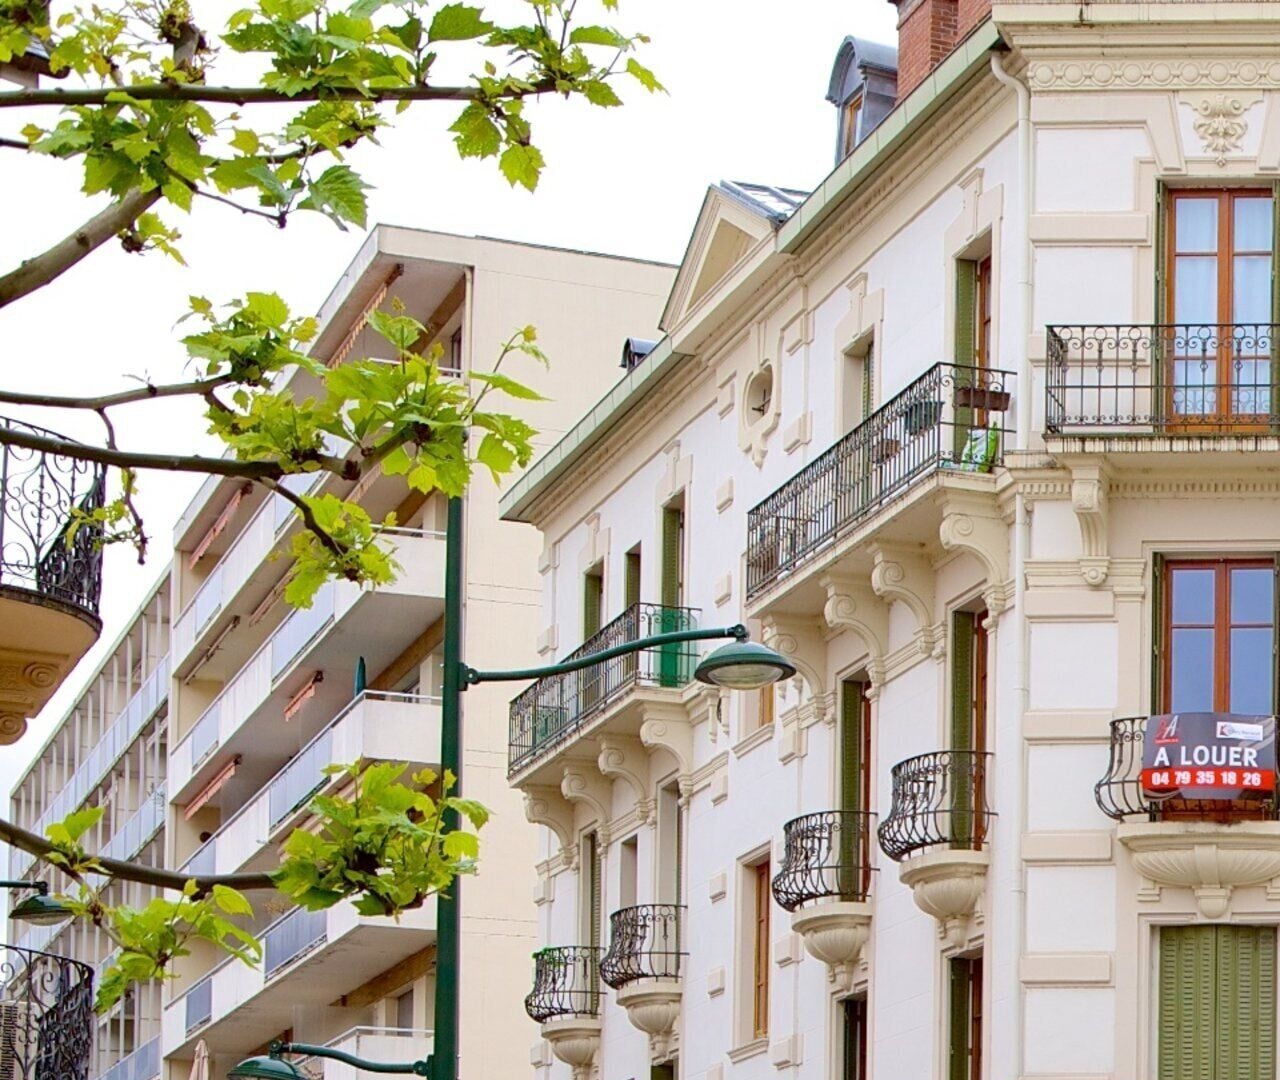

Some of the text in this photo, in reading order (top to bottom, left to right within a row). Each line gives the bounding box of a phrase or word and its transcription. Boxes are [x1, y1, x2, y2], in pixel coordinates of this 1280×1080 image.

[1153, 745, 1258, 767] A LOUER
[1151, 770, 1261, 787] 04 79 35 18 26
